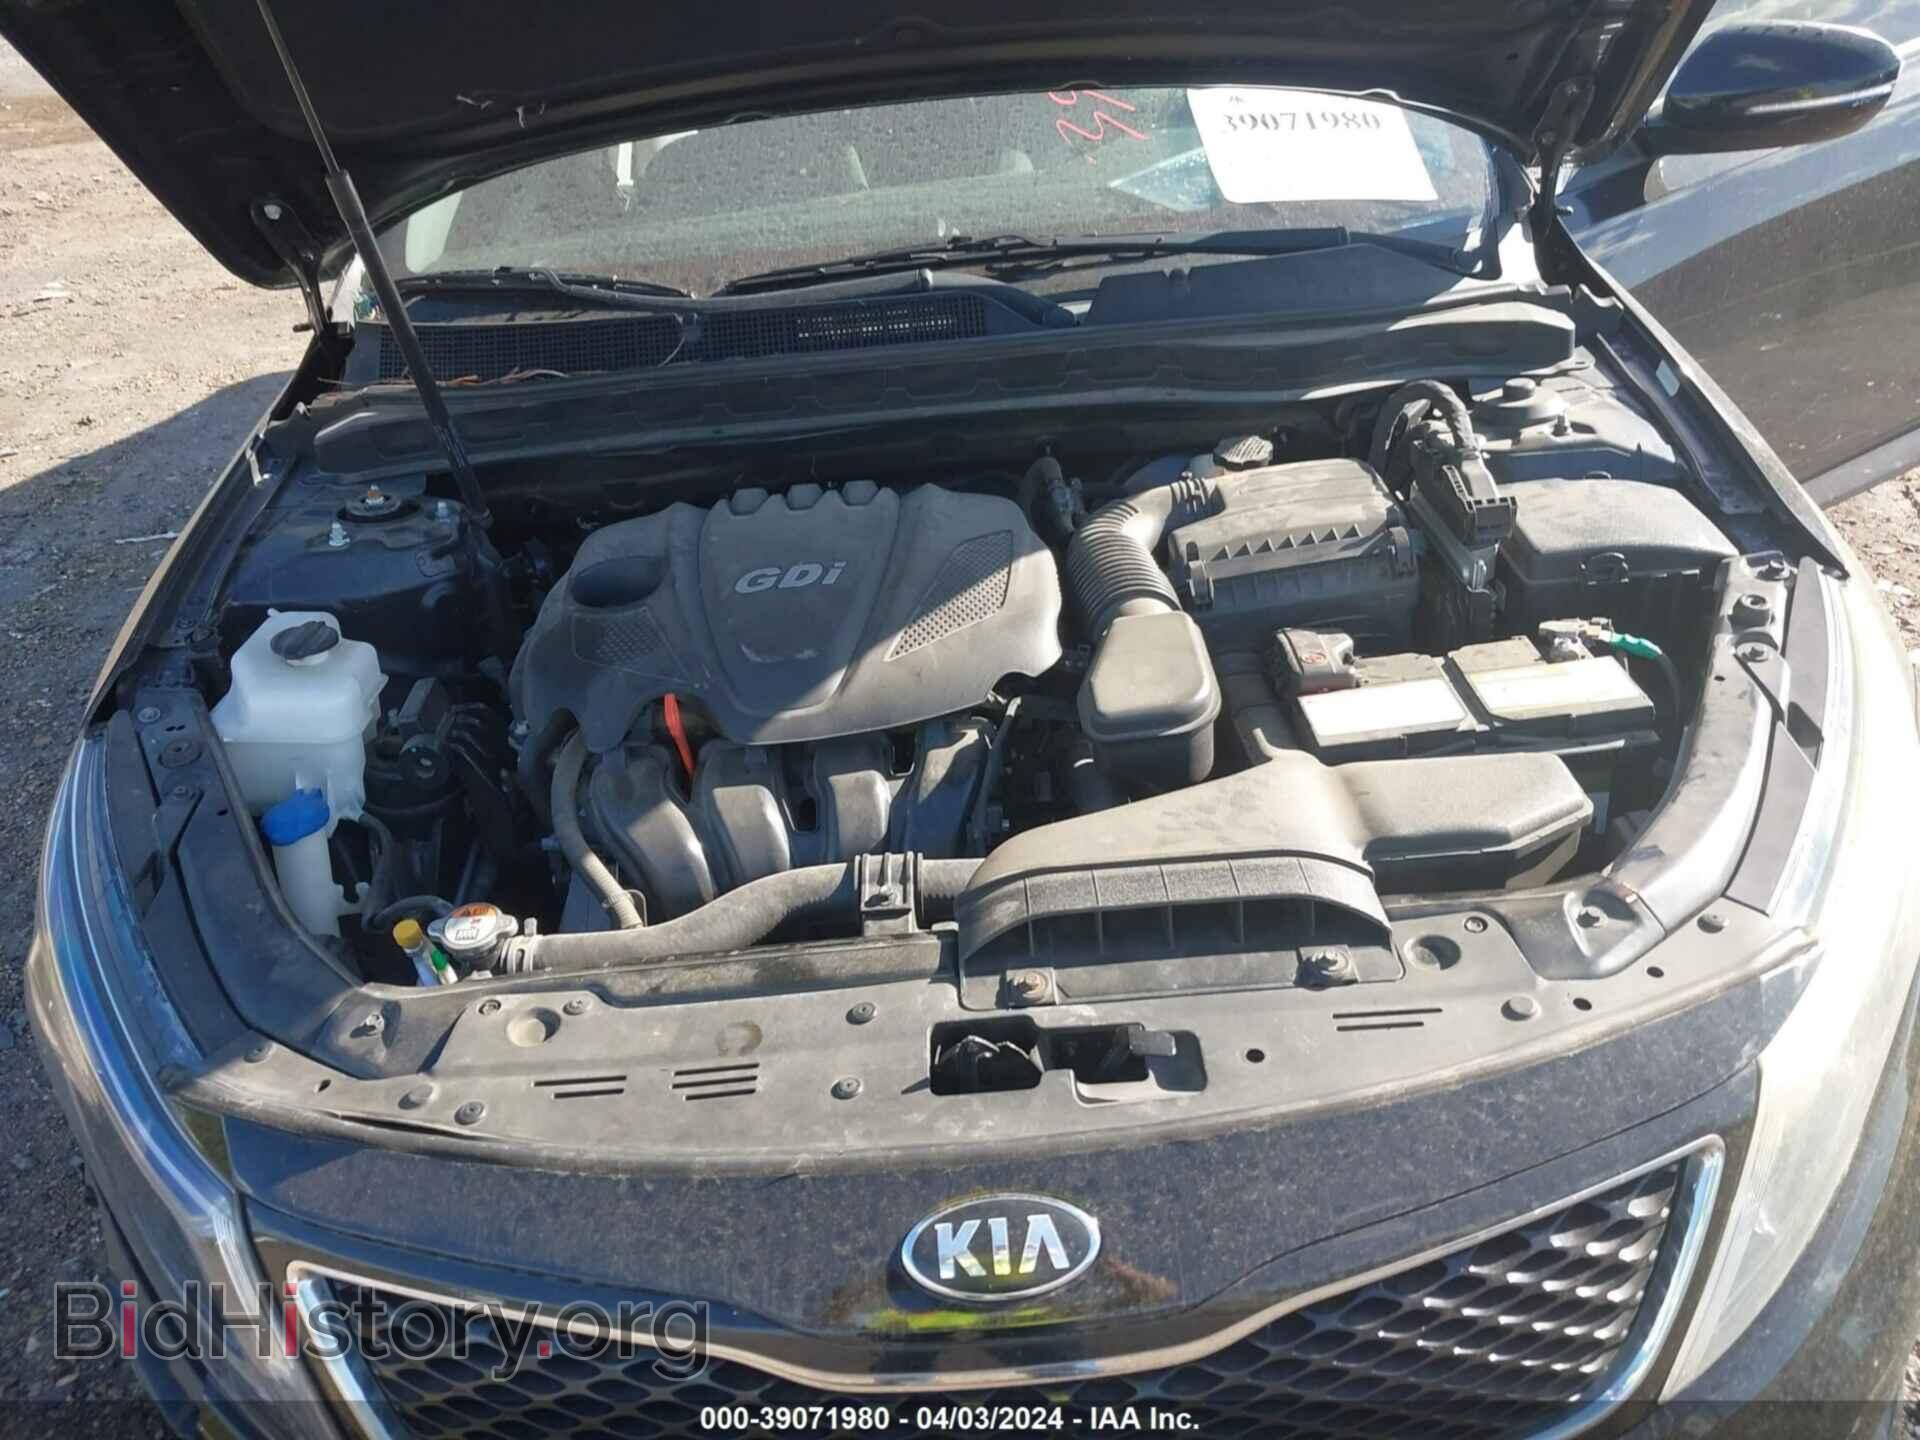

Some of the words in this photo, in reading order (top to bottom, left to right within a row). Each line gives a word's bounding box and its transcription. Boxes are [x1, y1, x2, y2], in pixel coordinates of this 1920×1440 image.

[1223, 111, 1381, 131] 39071980
[735, 561, 847, 593] GDi
[934, 1214, 1070, 1279] KIA
